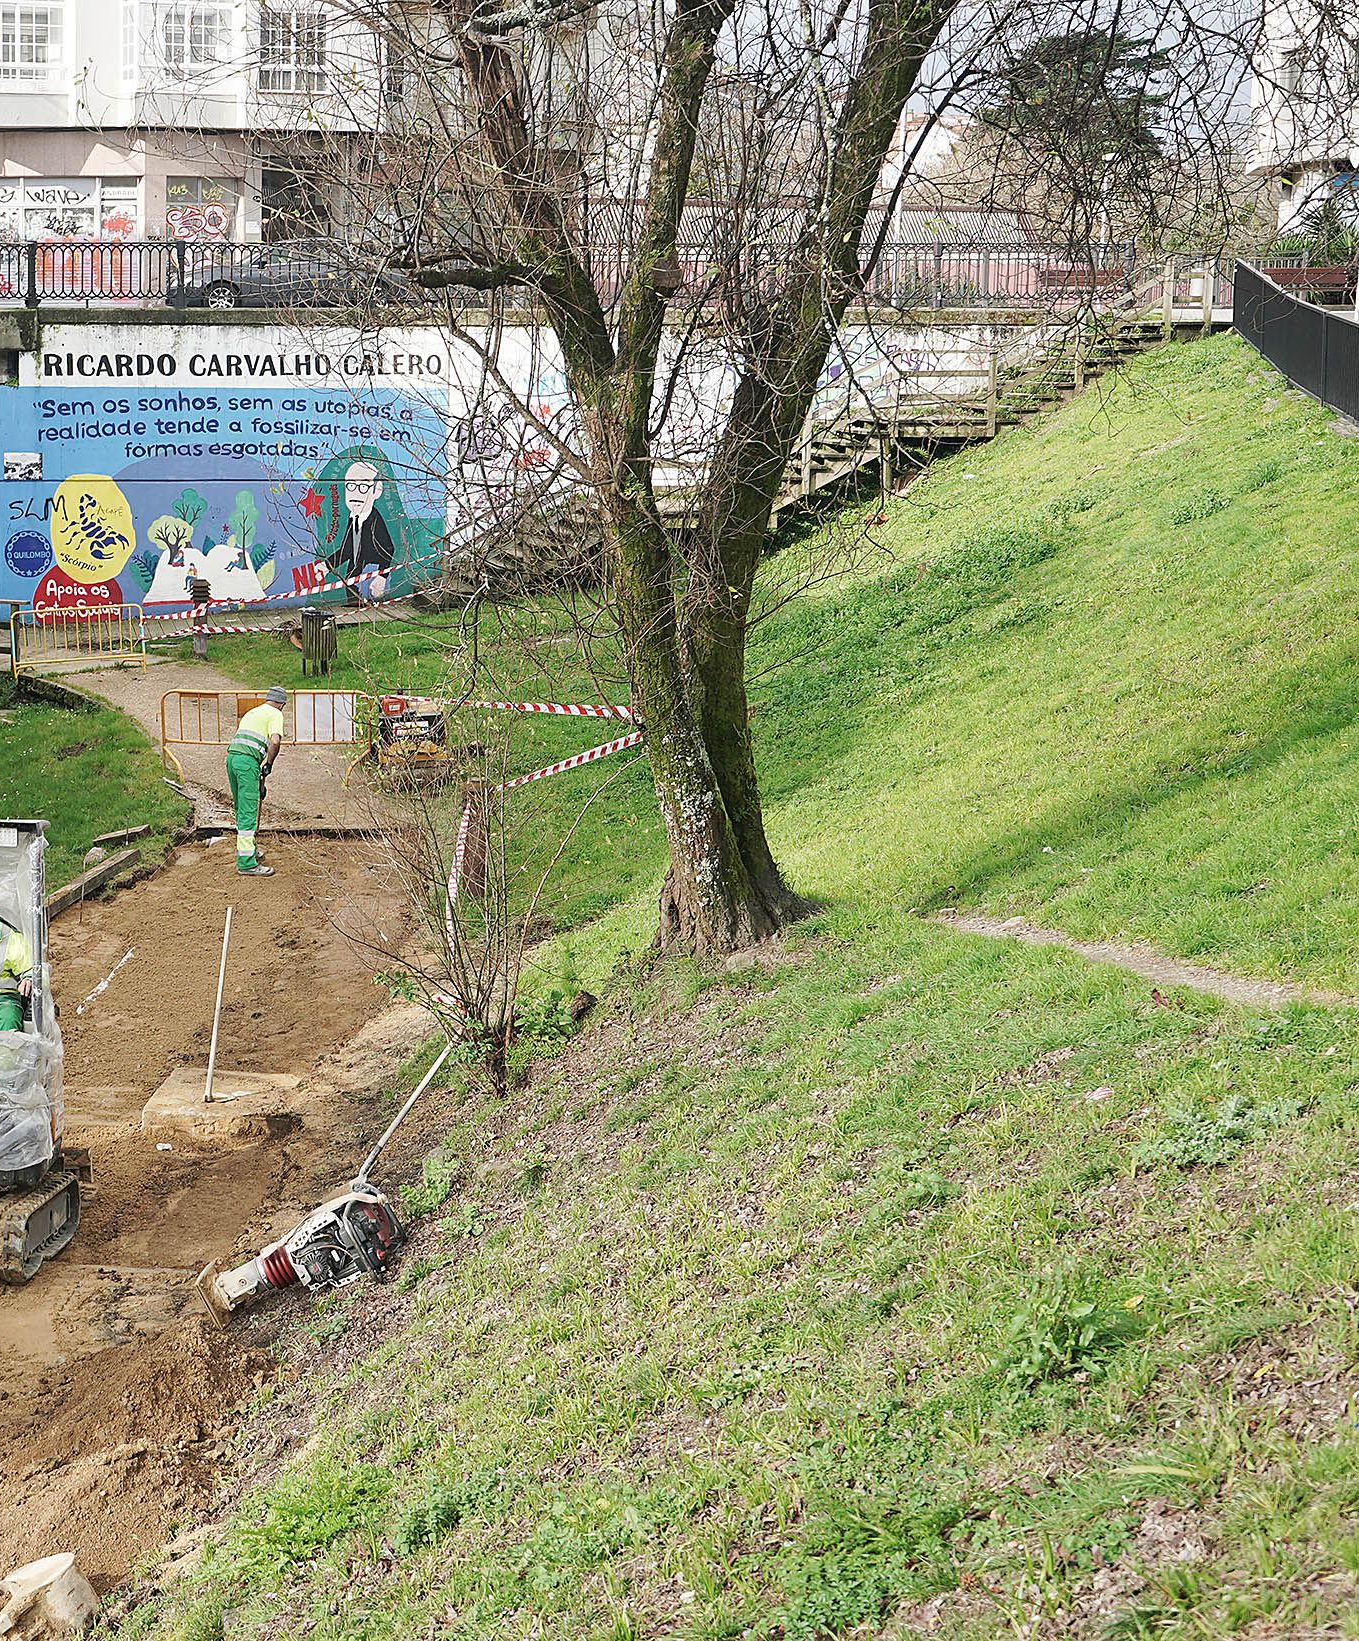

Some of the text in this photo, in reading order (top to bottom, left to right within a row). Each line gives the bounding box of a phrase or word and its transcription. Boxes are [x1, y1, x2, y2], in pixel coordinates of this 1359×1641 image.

[43, 353, 442, 377] RICARDO CARVALHO CALERO
[102, 399, 130, 413] os
[138, 391, 221, 413] sonhos,
[228, 397, 273, 411] sem
[282, 398, 307, 412] as
[400, 408, 412, 421] a
[38, 417, 411, 442] realidade tende a fossilizar-se em
[124, 441, 203, 458] formas
[9, 495, 68, 521] SLM
[13, 550, 51, 559] QUILOMBO
[46, 579, 110, 602] Apoia os
